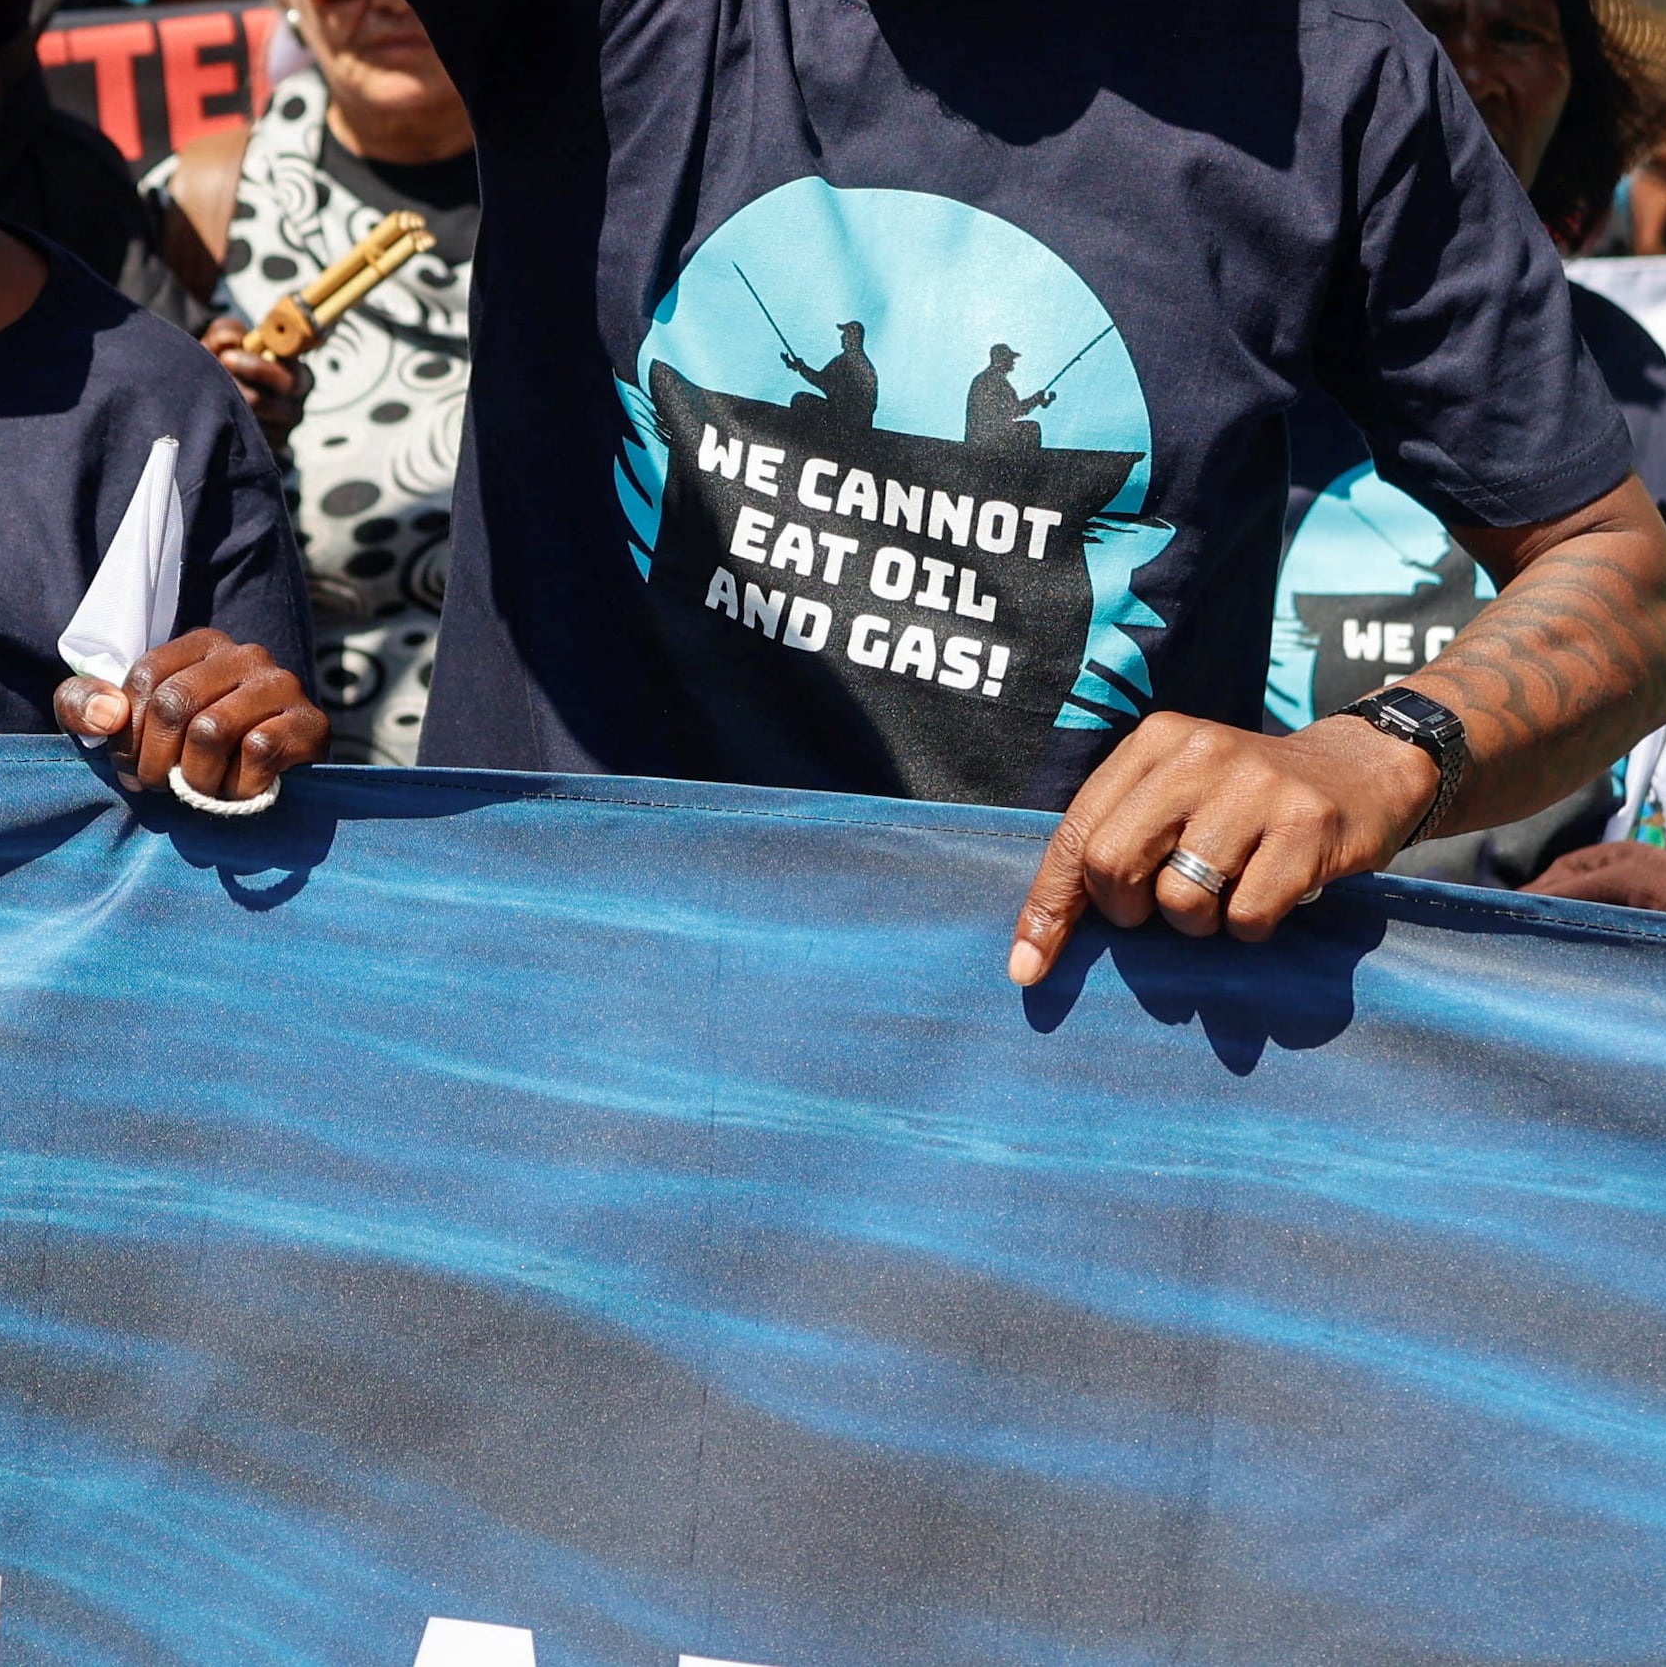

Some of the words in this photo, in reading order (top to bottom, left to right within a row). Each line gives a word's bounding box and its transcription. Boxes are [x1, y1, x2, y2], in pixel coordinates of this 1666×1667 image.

[697, 422, 786, 497] WE
[797, 457, 1063, 561] CANNOT
[729, 505, 859, 585] EAT
[869, 546, 998, 623] OIL
[704, 565, 833, 653] AND
[847, 614, 1011, 698] GAS!
[1342, 618, 1414, 664] WE
